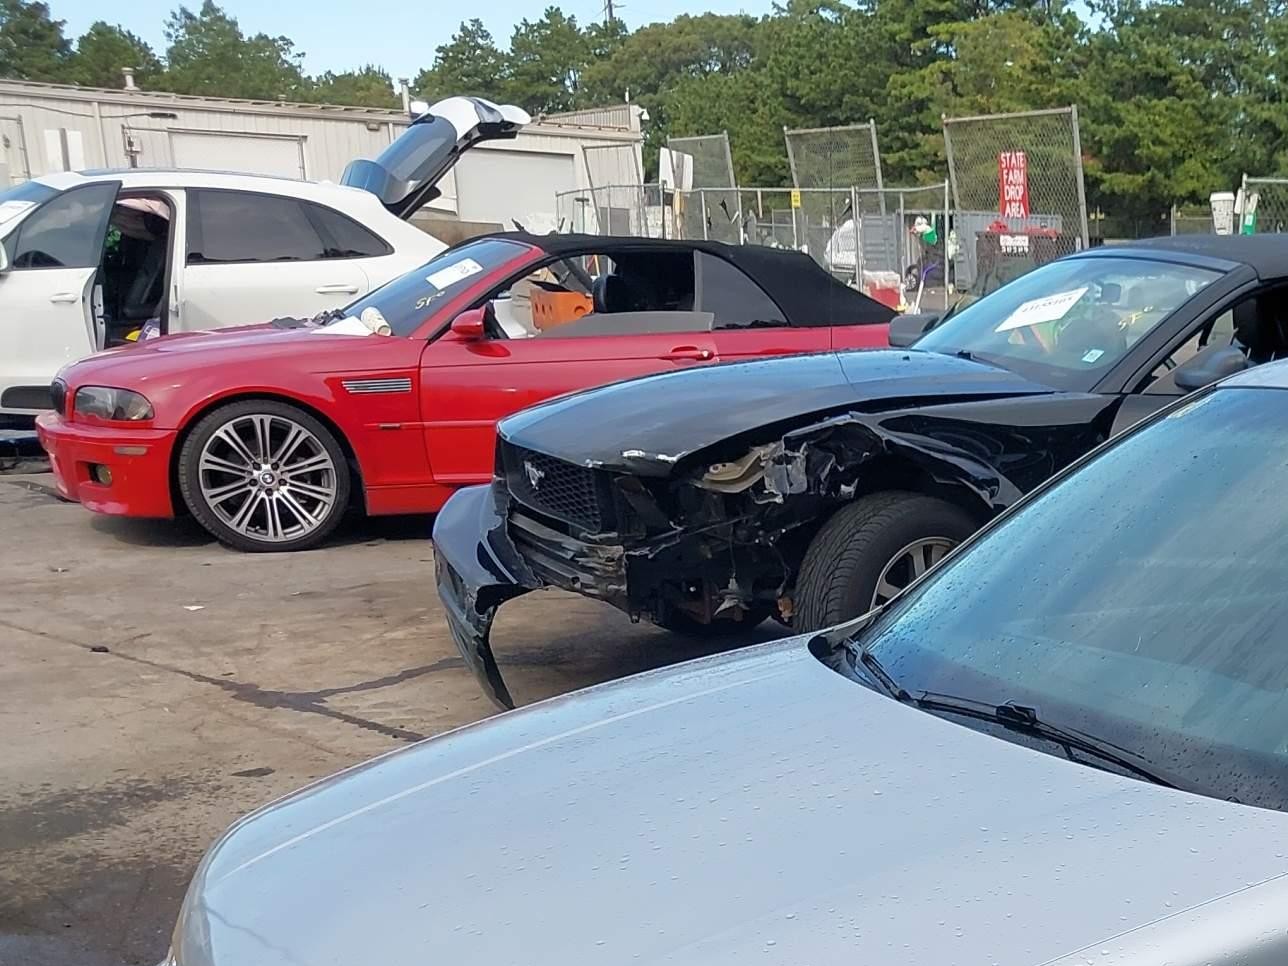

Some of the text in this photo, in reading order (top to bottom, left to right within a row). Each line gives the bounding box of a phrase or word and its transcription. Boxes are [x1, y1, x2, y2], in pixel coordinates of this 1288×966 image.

[1000, 152, 1025, 168] STATE
[1003, 169, 1024, 182] FARM
[1004, 186, 1024, 201] DROP
[1004, 202, 1026, 218] AREA
